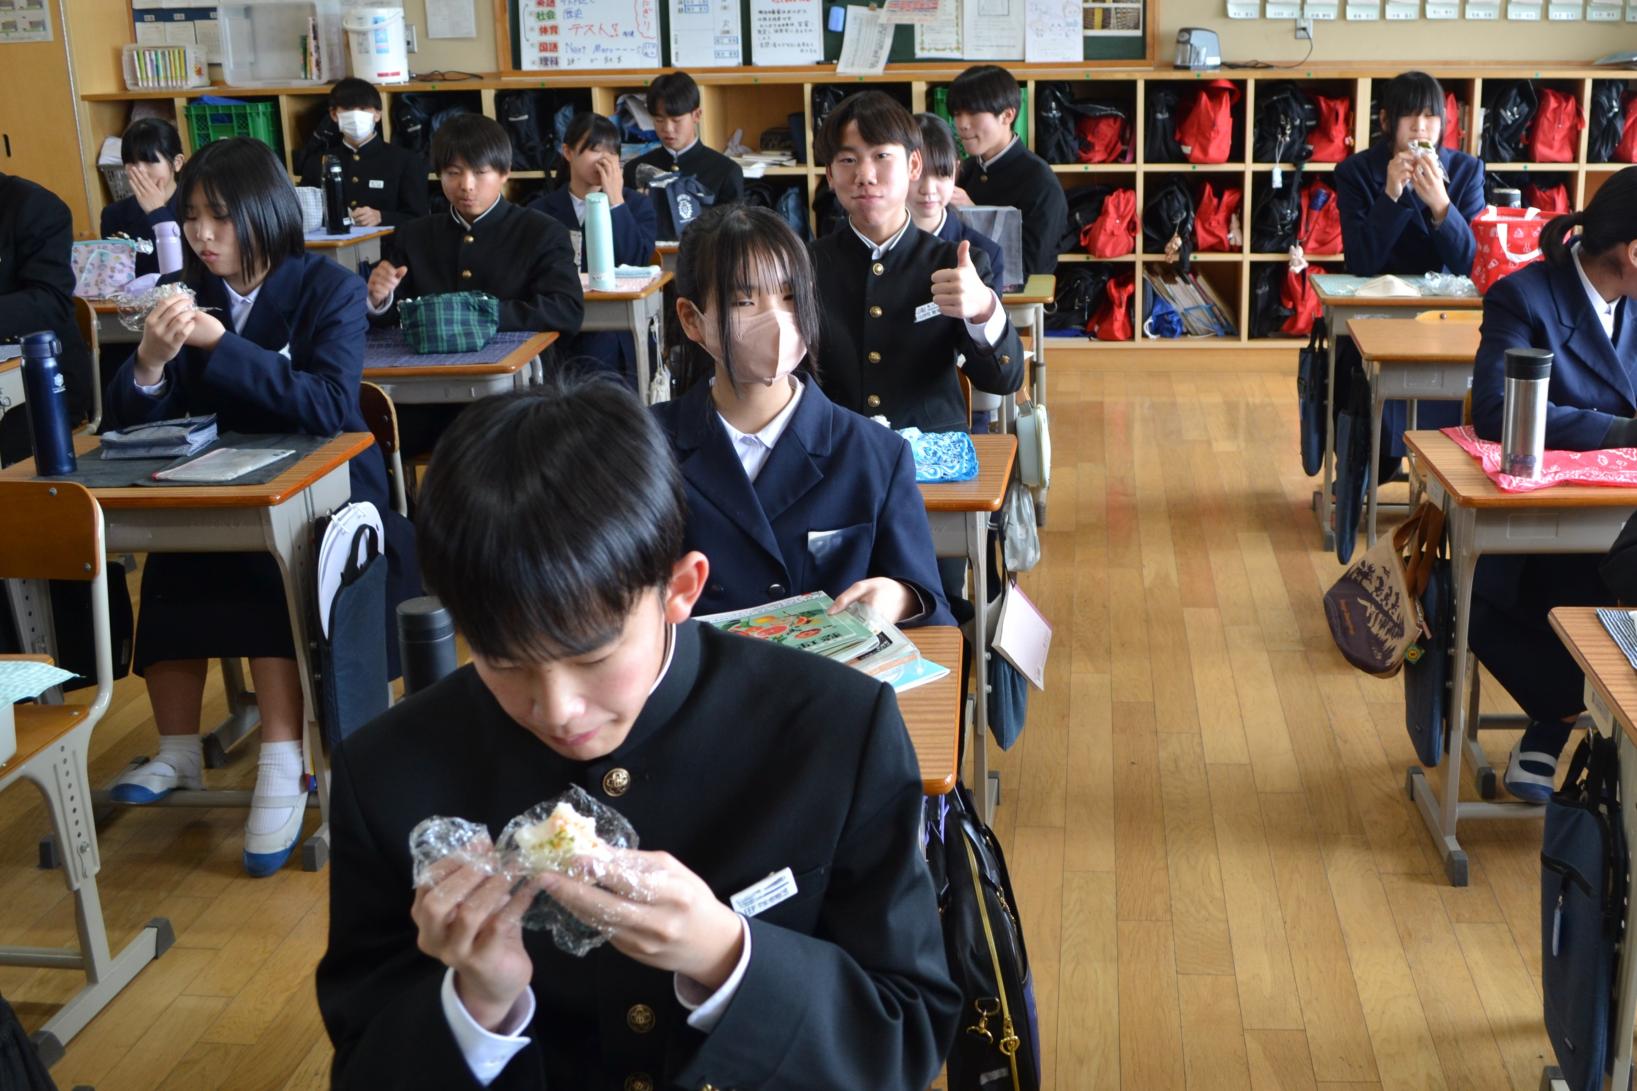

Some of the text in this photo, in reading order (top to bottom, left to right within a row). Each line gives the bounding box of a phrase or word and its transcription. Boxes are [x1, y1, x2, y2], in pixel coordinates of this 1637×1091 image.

[536, 9, 556, 21] 社会
[539, 24, 559, 36] 体育
[538, 41, 559, 52] 国語
[539, 56, 559, 66] 理科
